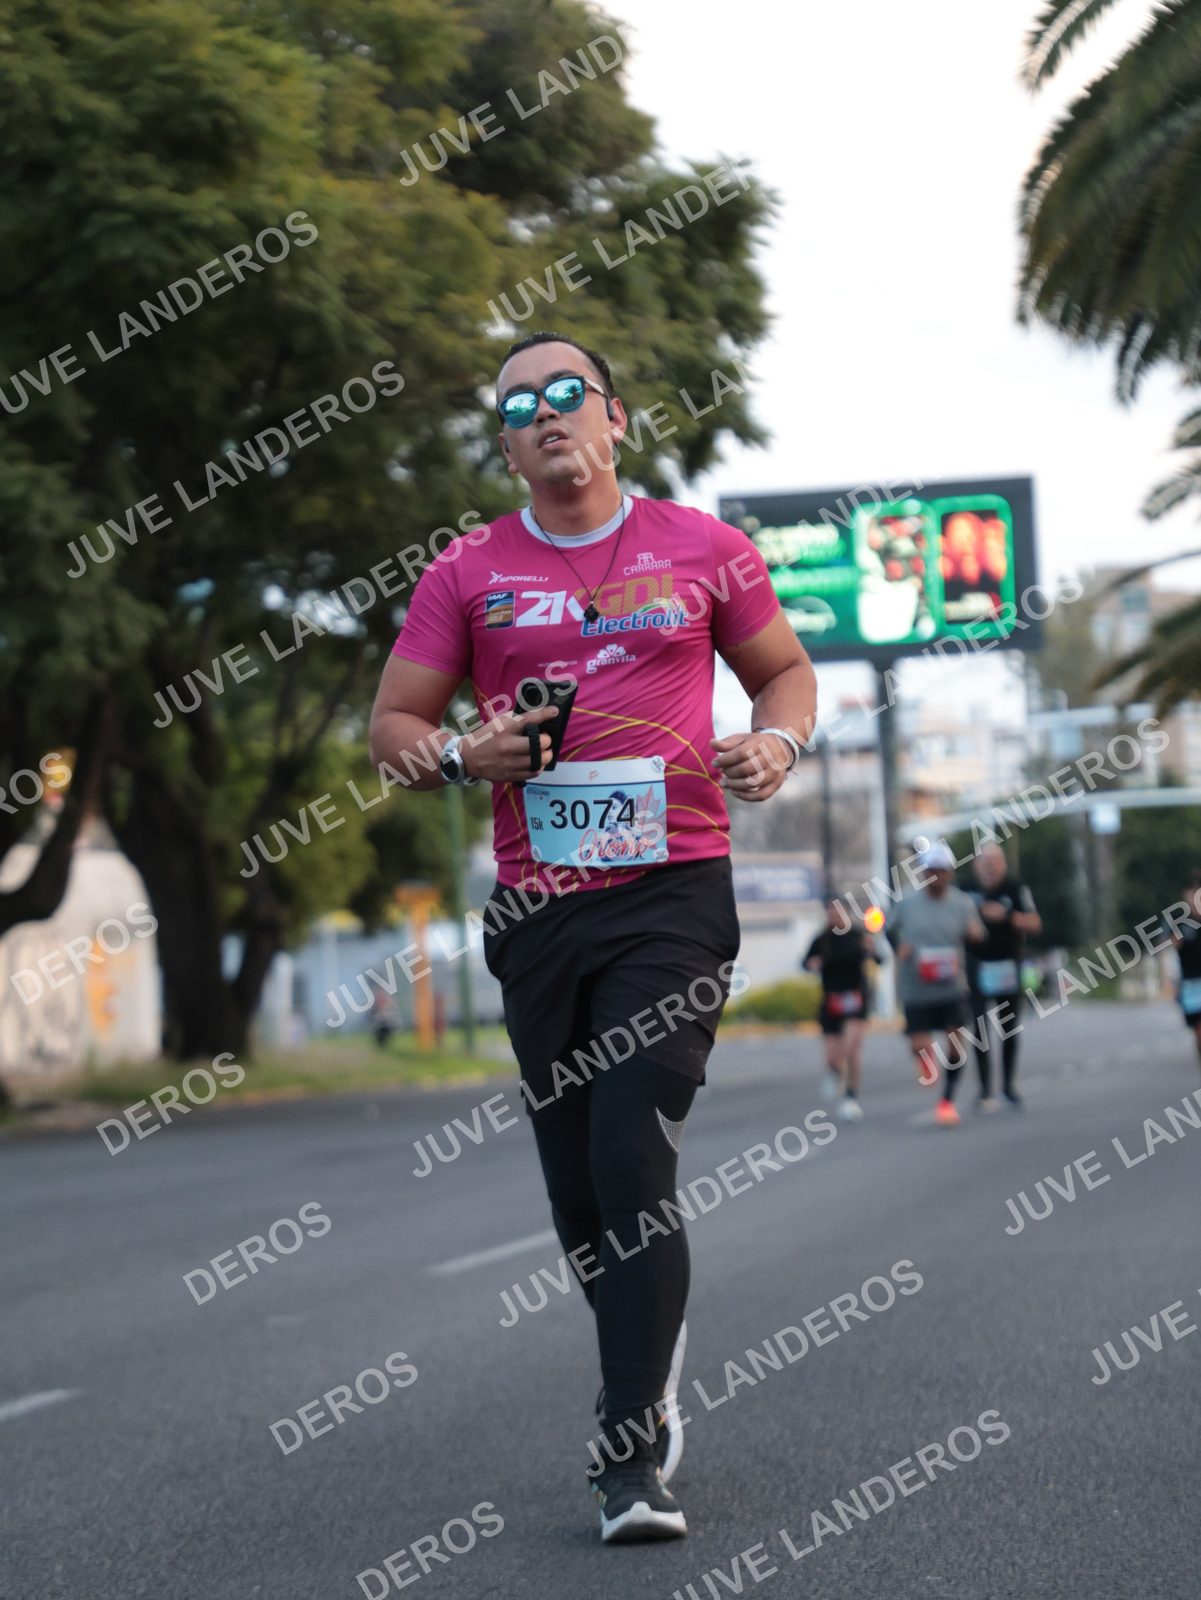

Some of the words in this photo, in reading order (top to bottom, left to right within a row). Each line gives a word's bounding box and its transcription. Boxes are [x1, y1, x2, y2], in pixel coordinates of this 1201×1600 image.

[581, 606, 689, 637] Electrolit
[586, 654, 637, 674] granvita
[530, 817, 544, 831] 15k
[550, 798, 635, 830] 3074
